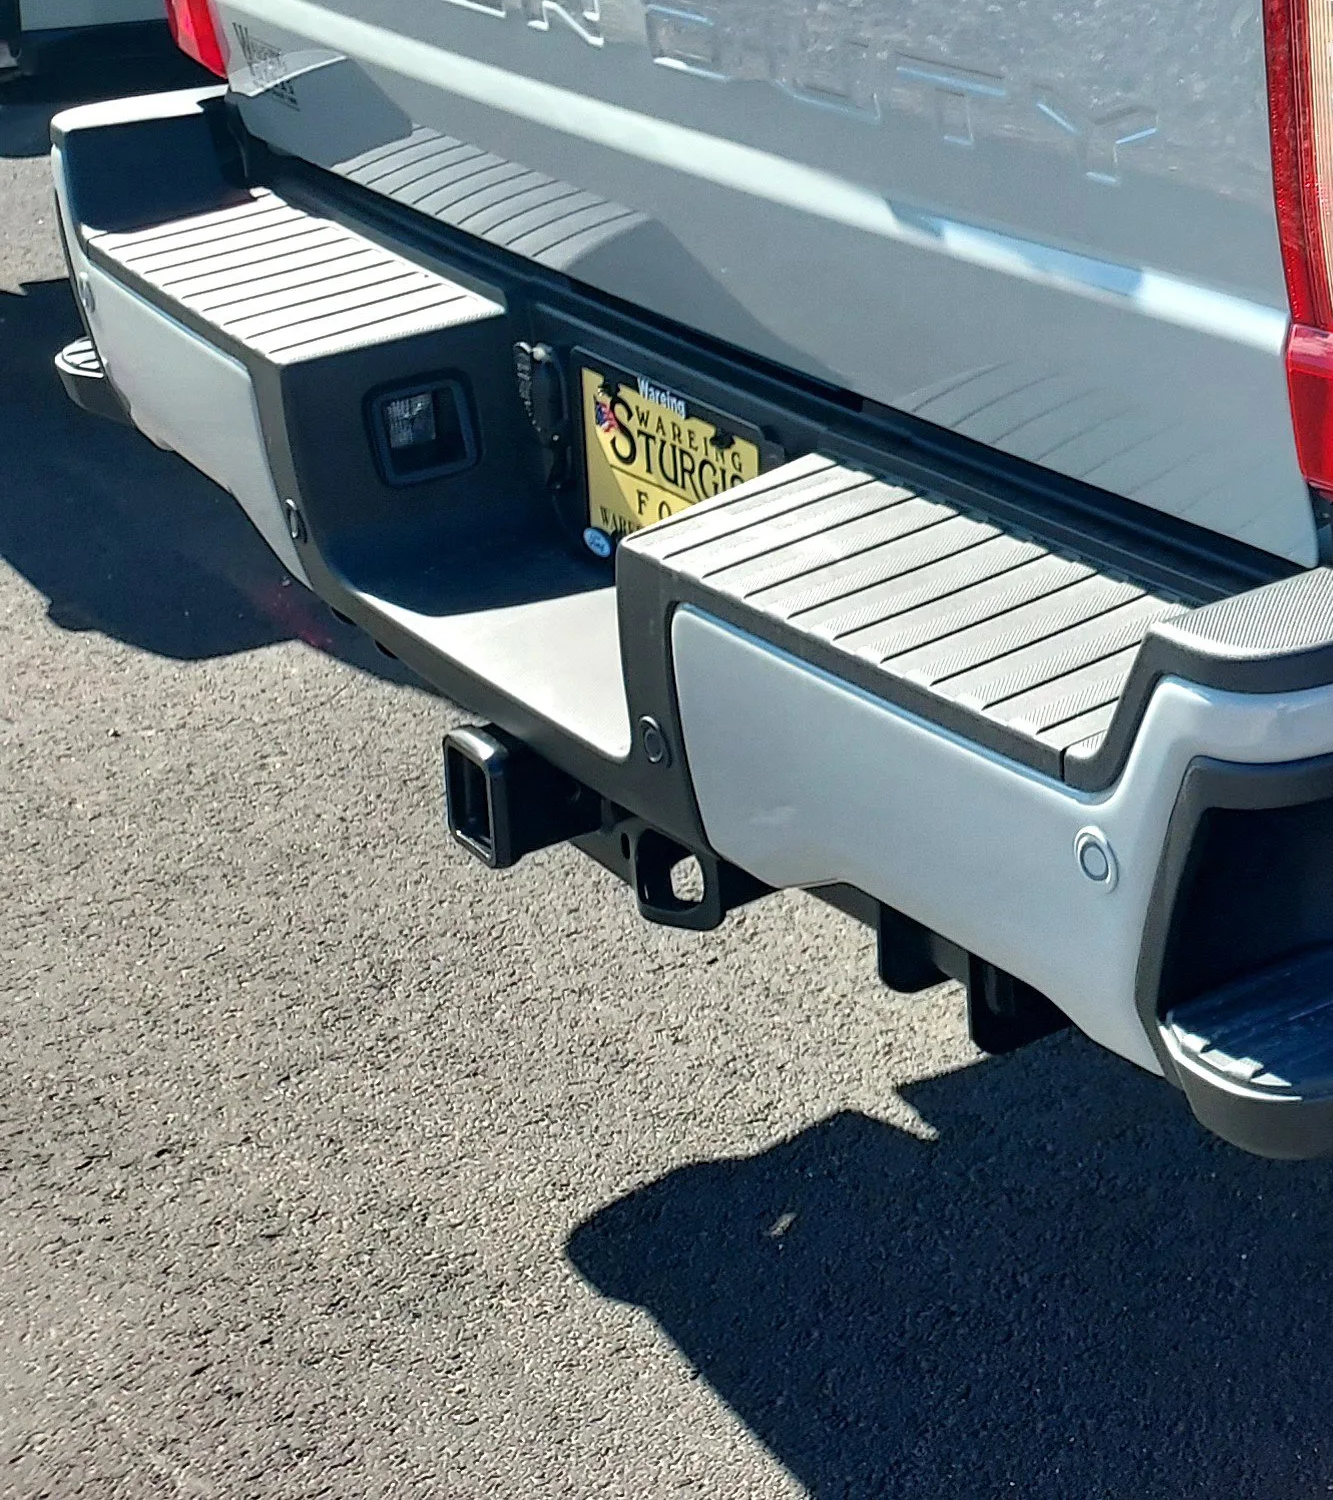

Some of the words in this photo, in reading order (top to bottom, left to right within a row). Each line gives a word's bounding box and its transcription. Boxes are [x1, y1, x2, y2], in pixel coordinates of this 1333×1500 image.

[636, 376, 687, 420] Wareing
[634, 404, 743, 473] WAREING
[635, 488, 673, 521] FO
